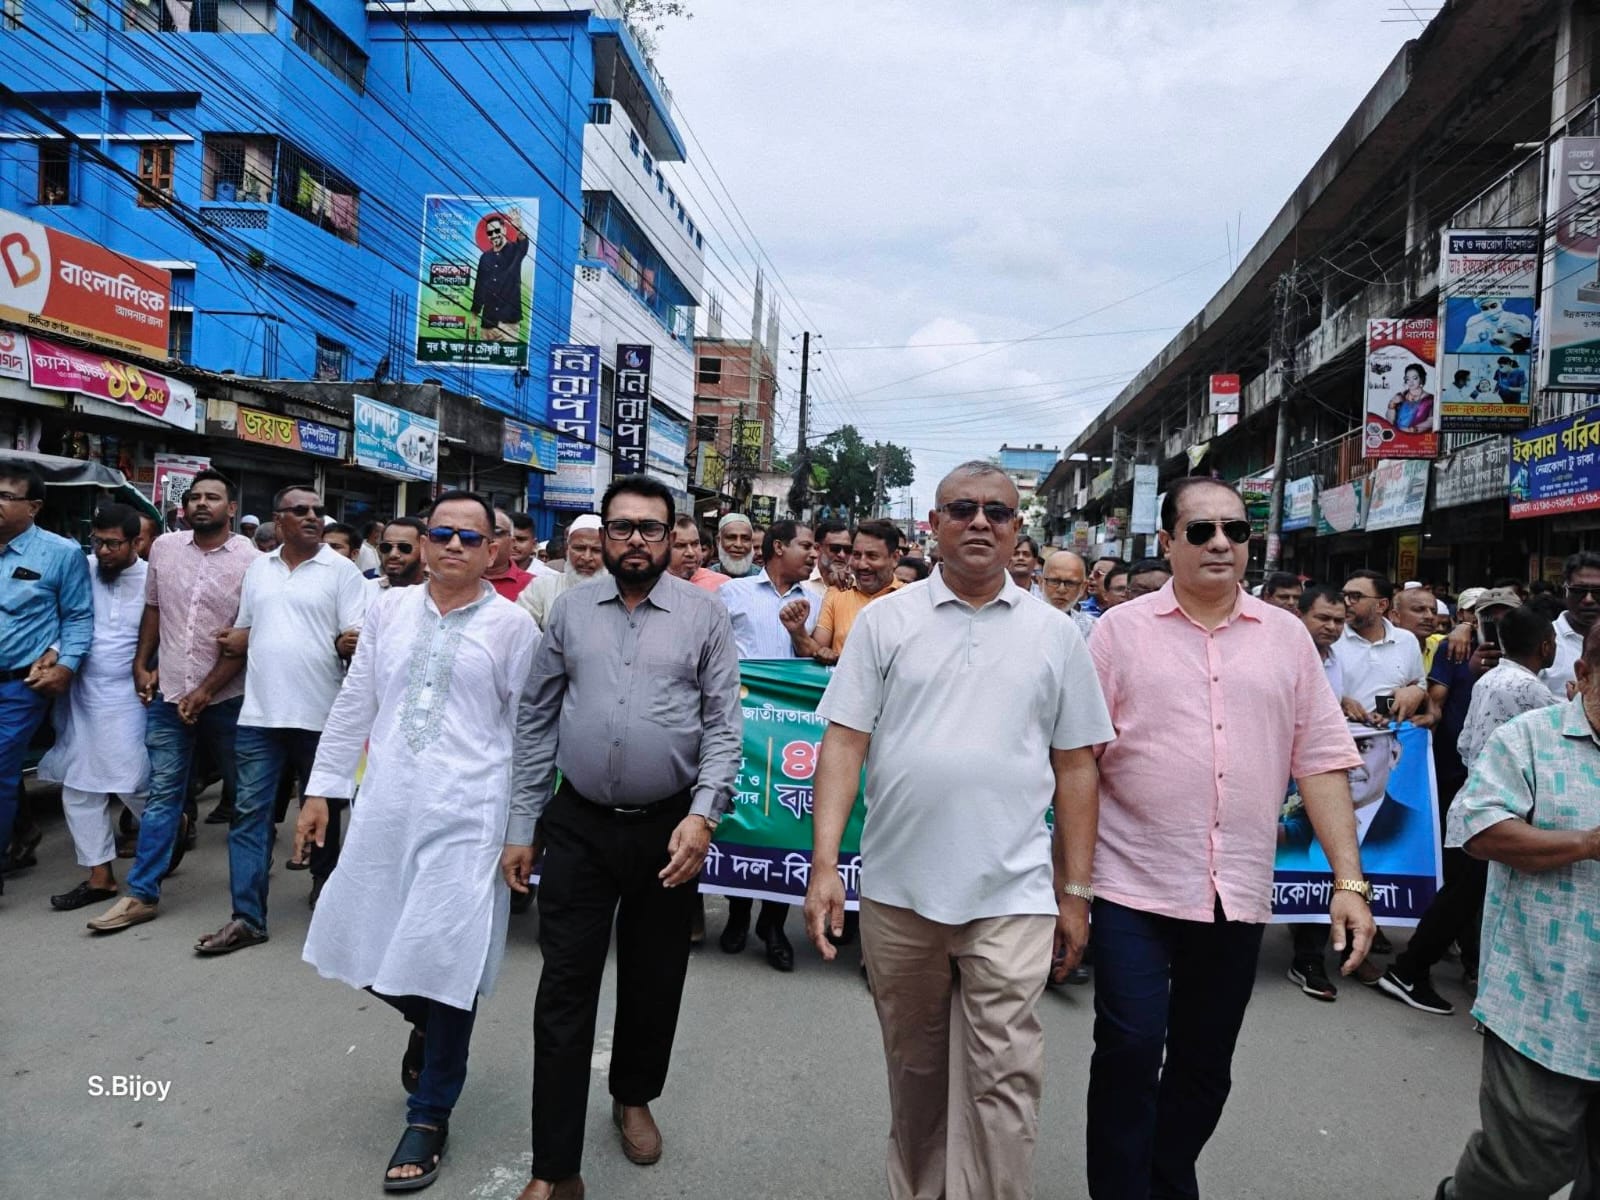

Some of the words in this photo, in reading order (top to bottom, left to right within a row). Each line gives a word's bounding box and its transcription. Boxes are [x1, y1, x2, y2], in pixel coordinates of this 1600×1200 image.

[60, 259, 165, 312] বাংলালিংক
[115, 304, 147, 325] আপনার
[1372, 319, 1404, 341] মা
[551, 348, 595, 441] নিরাপদ
[242, 410, 295, 443] জয়ন্ত
[617, 368, 649, 469] নিরাপদ
[782, 740, 822, 780] ৪
